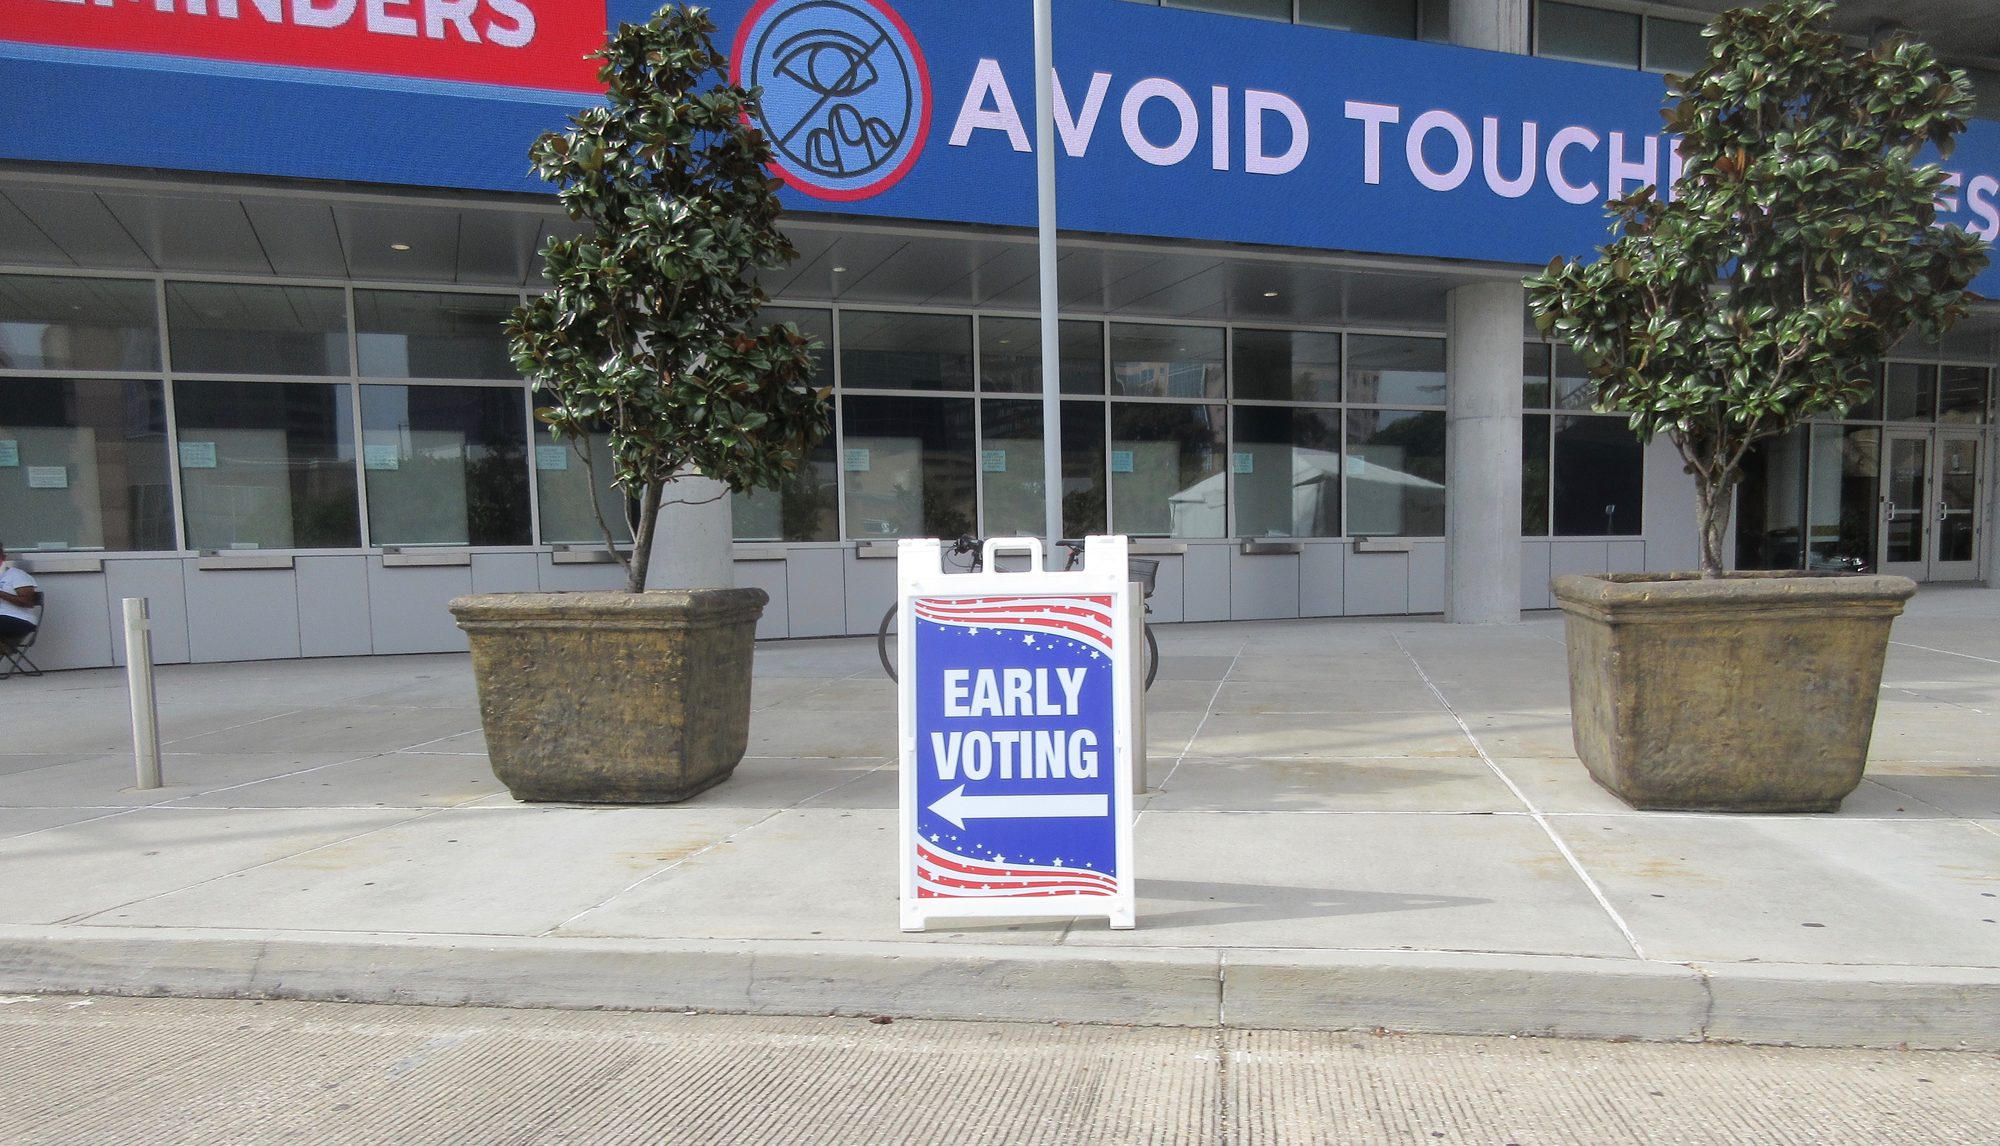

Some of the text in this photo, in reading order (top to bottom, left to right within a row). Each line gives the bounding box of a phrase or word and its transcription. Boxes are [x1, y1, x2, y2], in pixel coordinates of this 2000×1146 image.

[948, 58, 1310, 176] AVOID
[1345, 101, 1769, 217] TOUCHI
[943, 667, 1088, 717] EARLY
[930, 729, 1099, 781] VOTING
